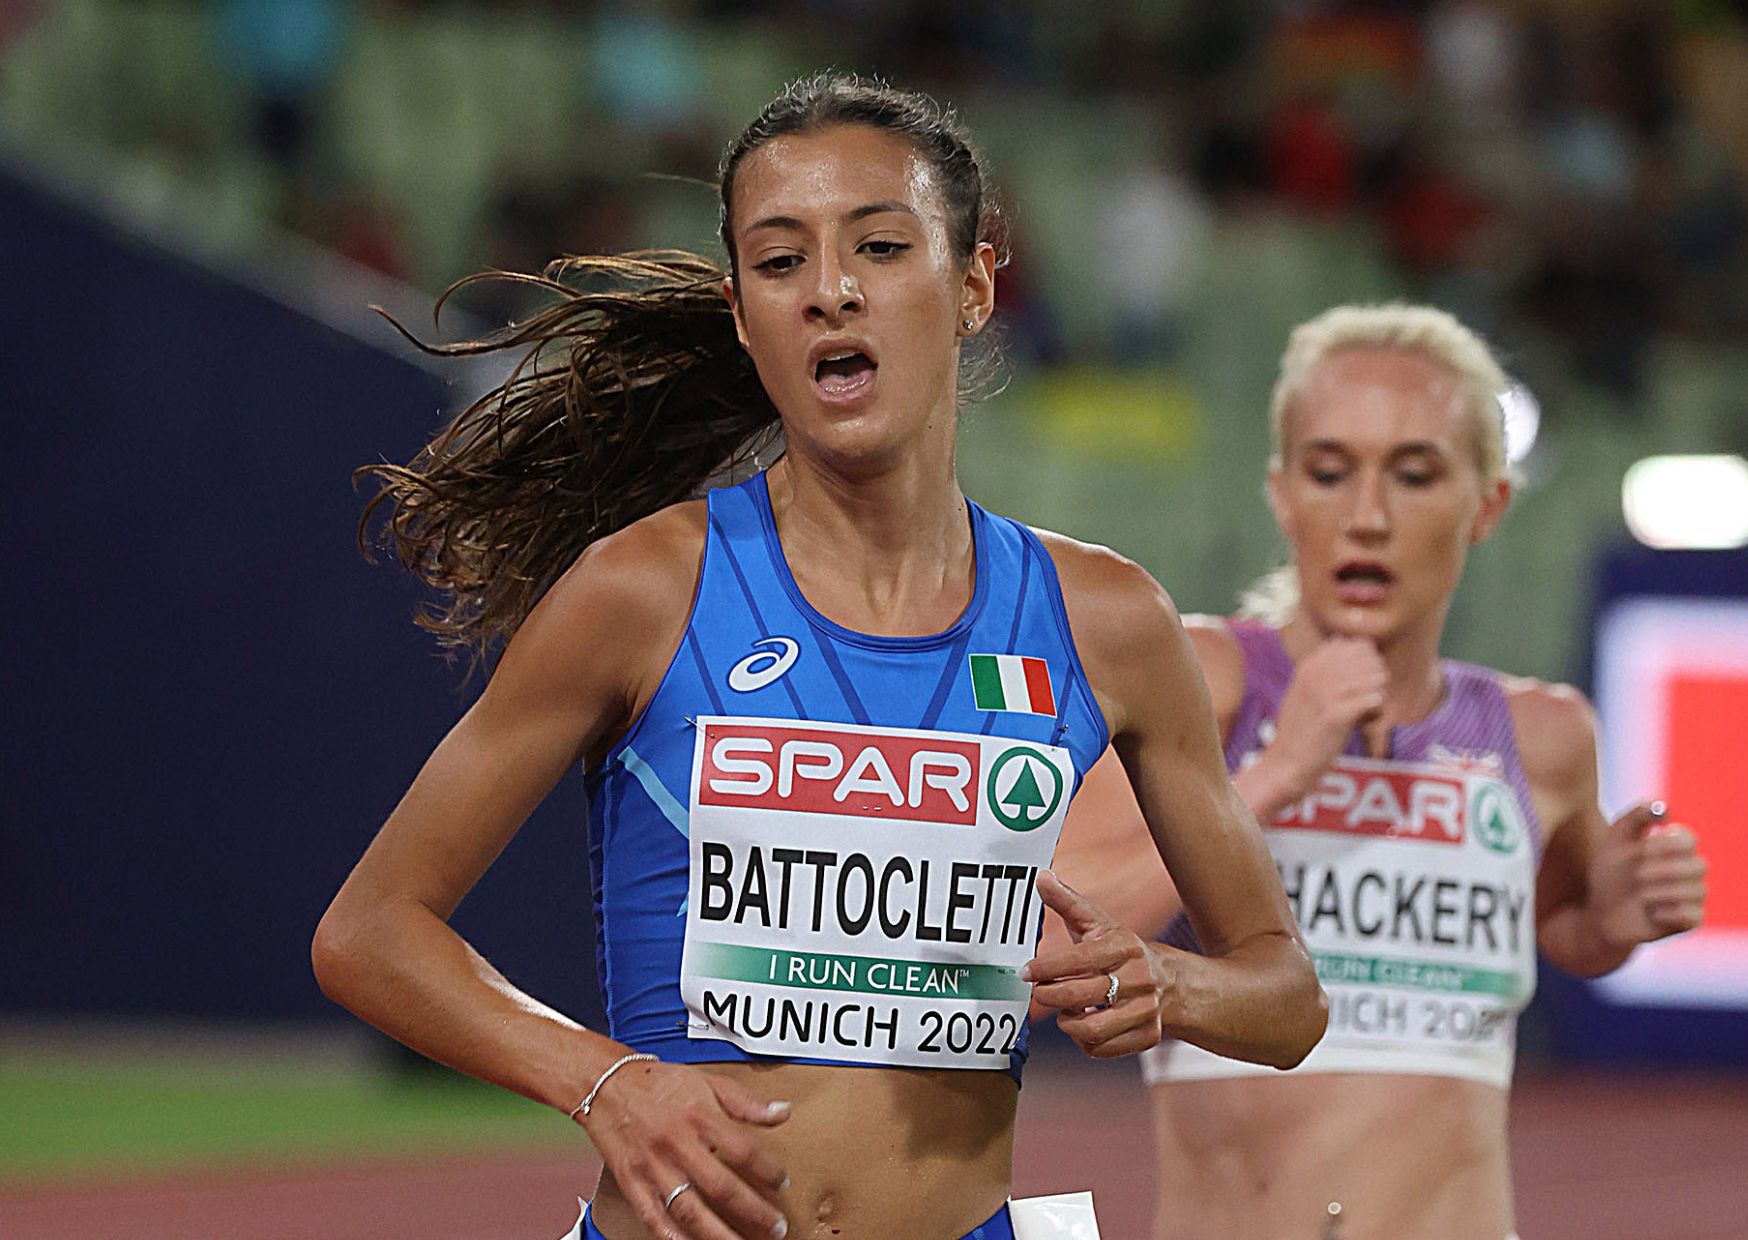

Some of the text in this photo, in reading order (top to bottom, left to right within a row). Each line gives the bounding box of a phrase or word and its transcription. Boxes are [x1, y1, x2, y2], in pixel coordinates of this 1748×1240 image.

[710, 738, 971, 812] SPAR
[1278, 774, 1462, 837] PAR
[700, 841, 1038, 946] BATTOCLETTI
[769, 954, 777, 981] I
[787, 958, 857, 987] RUN
[703, 991, 1018, 1055] MUNICH 2022
